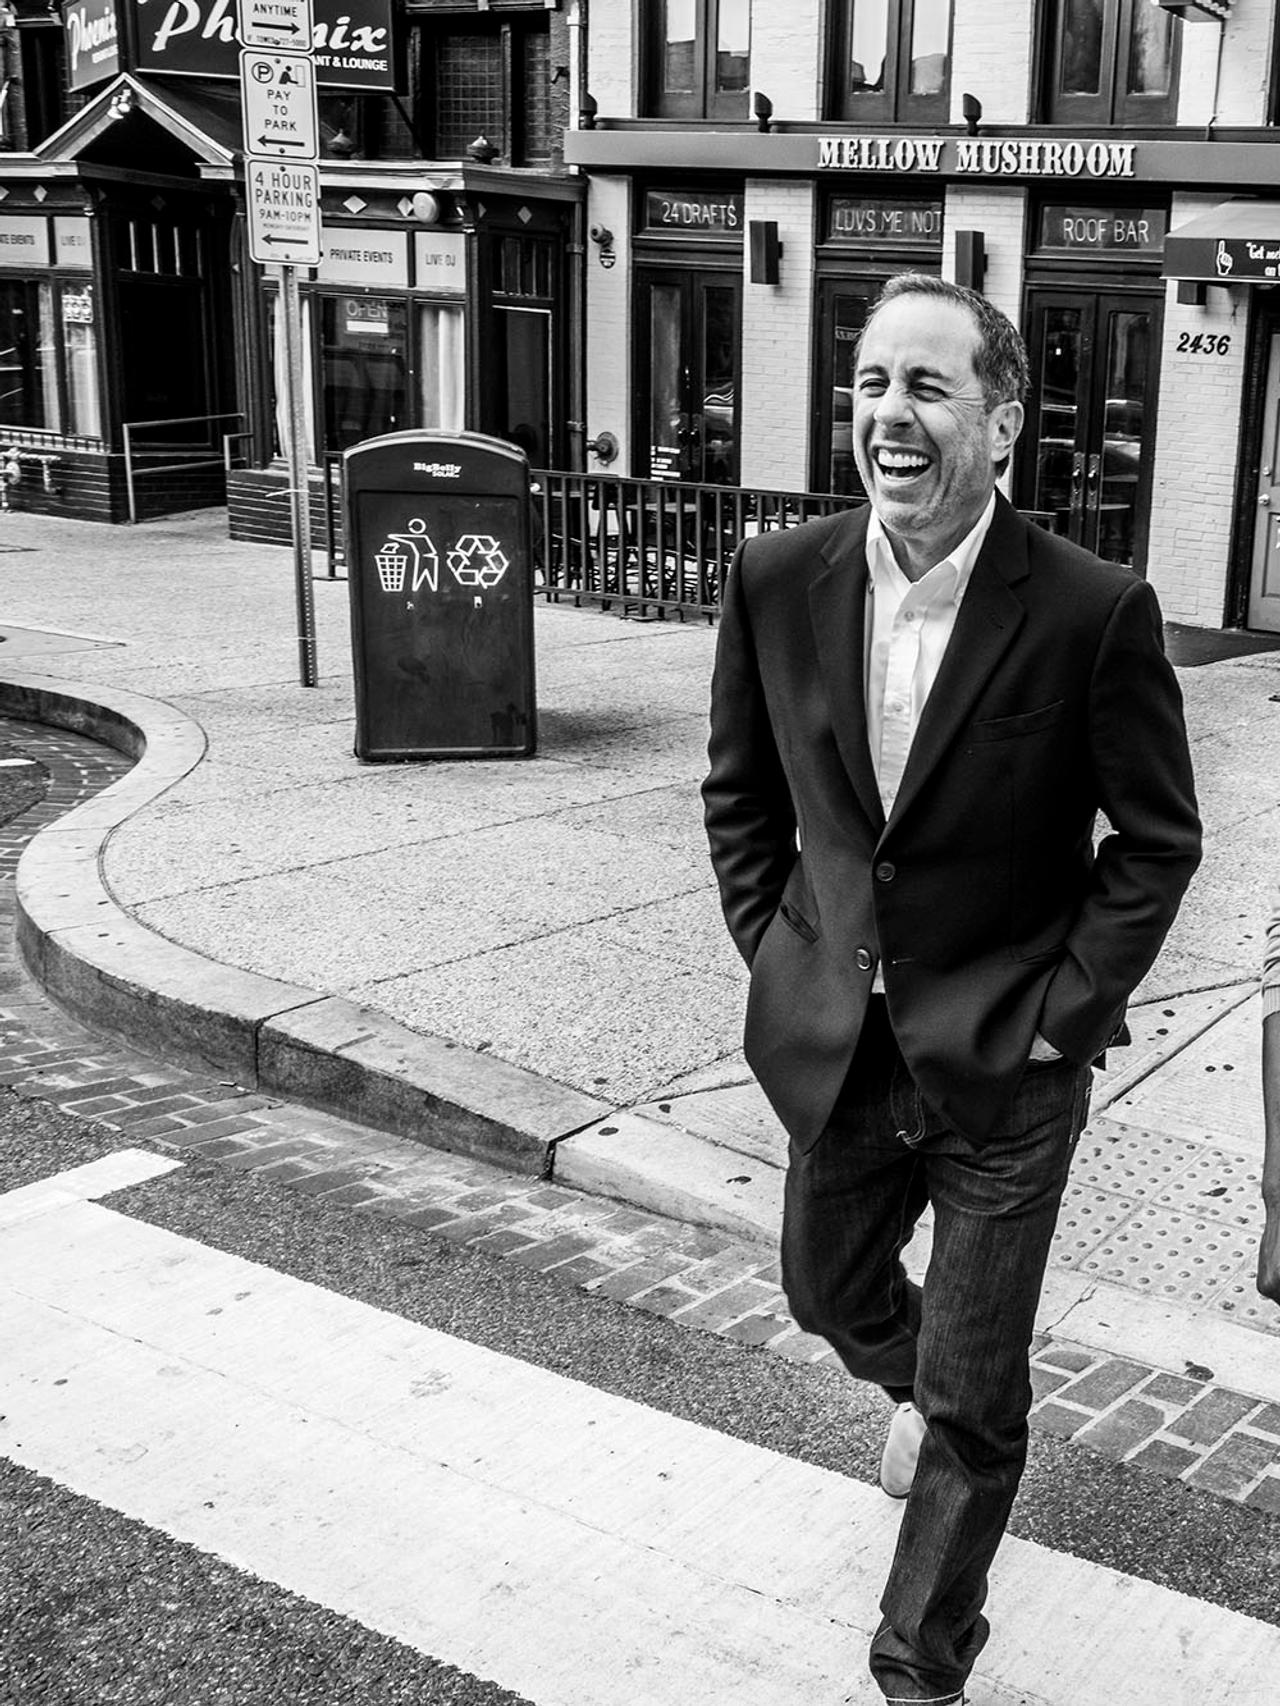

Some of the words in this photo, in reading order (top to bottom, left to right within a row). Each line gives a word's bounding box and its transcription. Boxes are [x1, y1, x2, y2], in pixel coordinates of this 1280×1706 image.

[253, 4, 298, 17] ANYTIME
[332, 57, 341, 67] &
[343, 57, 388, 71] LOUNGE
[267, 89, 291, 100] PAY
[273, 105, 288, 116] TO
[264, 119, 297, 131] PARK
[817, 138, 945, 171] MELLOW
[955, 140, 1136, 177] MUSHROOM
[255, 171, 264, 186] 4
[271, 172, 311, 190] HOUR
[255, 188, 312, 208] PARKING
[259, 208, 311, 222] 9AM-10PM
[662, 202, 679, 222] 24
[682, 203, 737, 226] DRAFTS
[881, 211, 903, 232] ME
[912, 211, 941, 233] NOT
[1063, 218, 1108, 242] ROOF
[1114, 220, 1149, 243] BAR
[329, 248, 361, 262] PRIVATE
[363, 250, 393, 264] EVENTS
[1176, 332, 1231, 356] 2436
